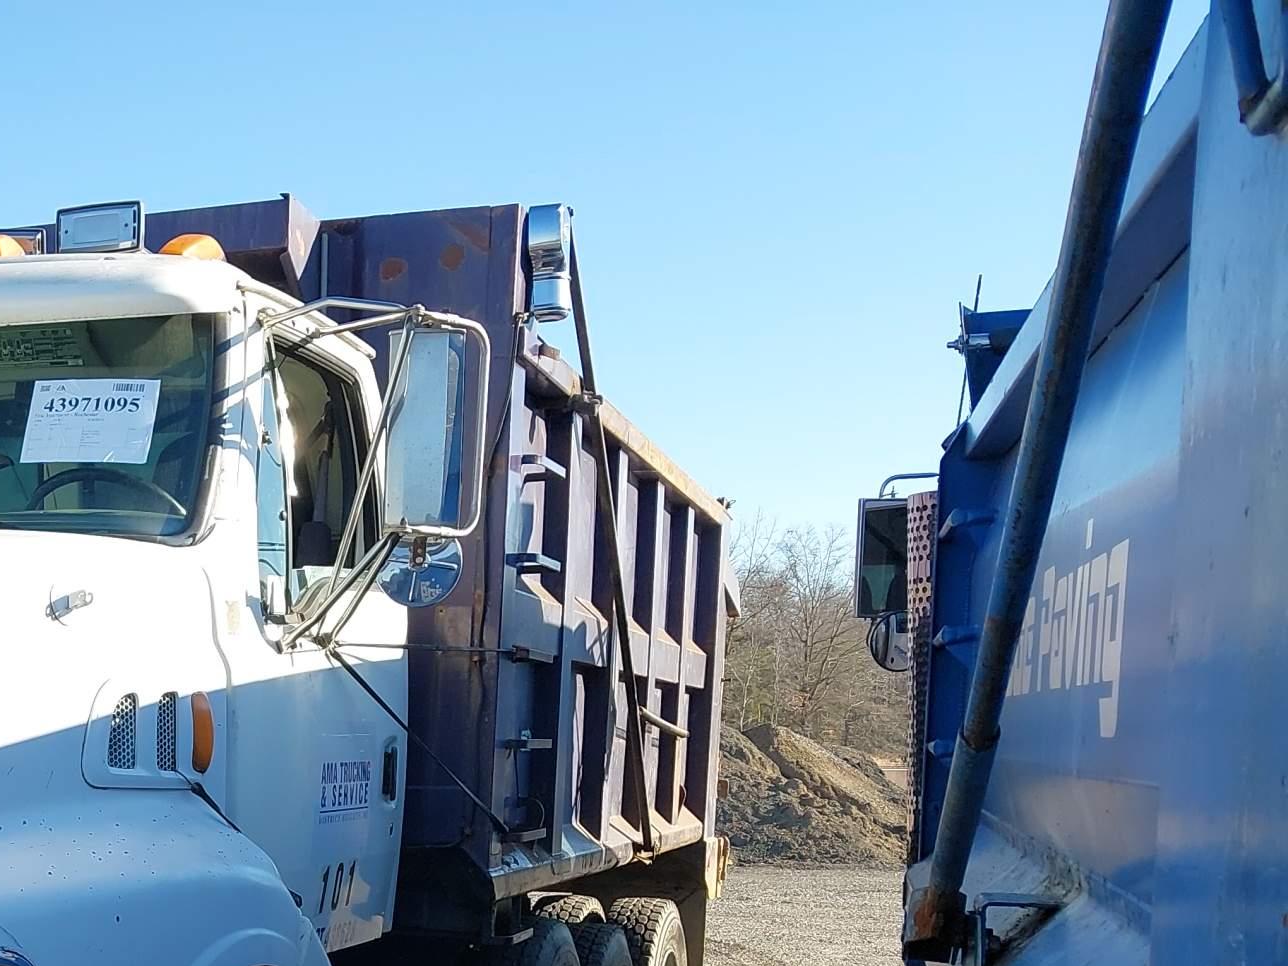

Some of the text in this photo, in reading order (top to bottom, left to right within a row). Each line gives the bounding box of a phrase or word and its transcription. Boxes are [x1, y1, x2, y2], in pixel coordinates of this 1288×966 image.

[43, 396, 142, 413] 43971095
[1036, 517, 1130, 738] Paving
[320, 760, 371, 785] AMA TRUCKING
[320, 782, 369, 808] & SERVICE
[318, 859, 357, 915] 101
